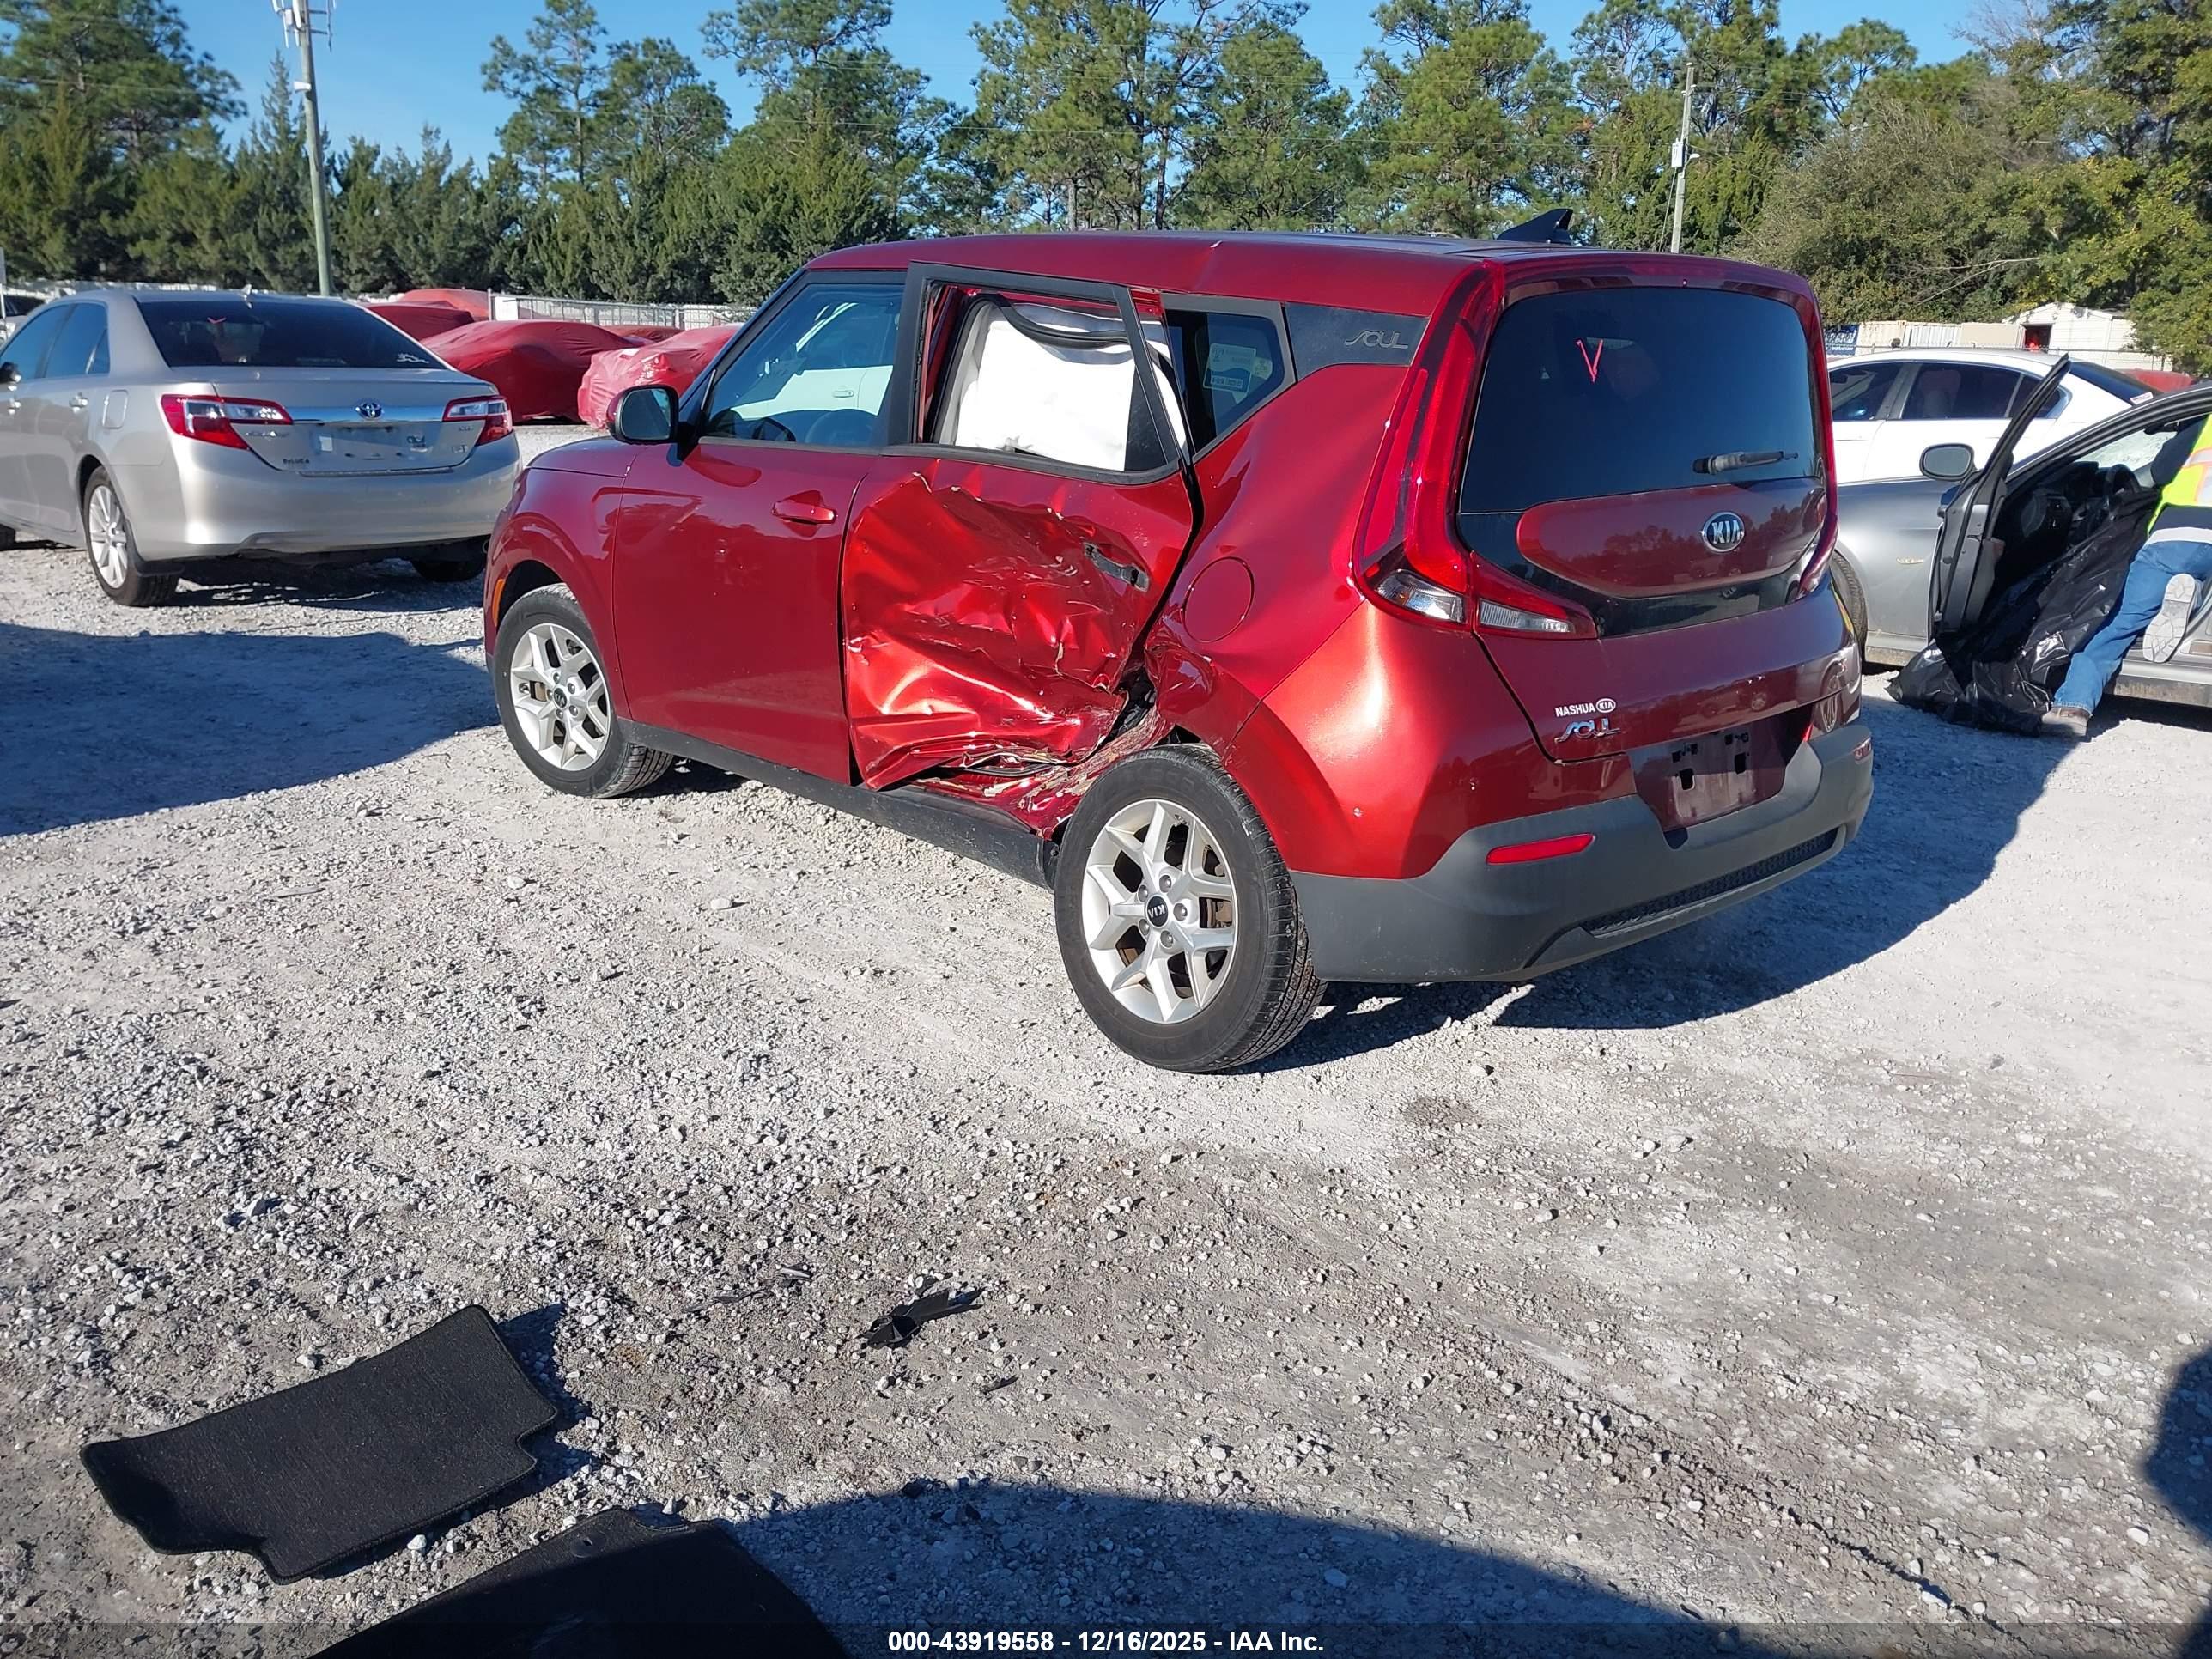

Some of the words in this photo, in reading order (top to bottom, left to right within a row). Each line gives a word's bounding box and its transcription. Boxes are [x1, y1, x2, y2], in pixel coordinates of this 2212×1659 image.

[1711, 520, 1741, 544] KIA
[1555, 703, 1596, 717] NASHUA
[1554, 718, 1621, 744] SOUL
